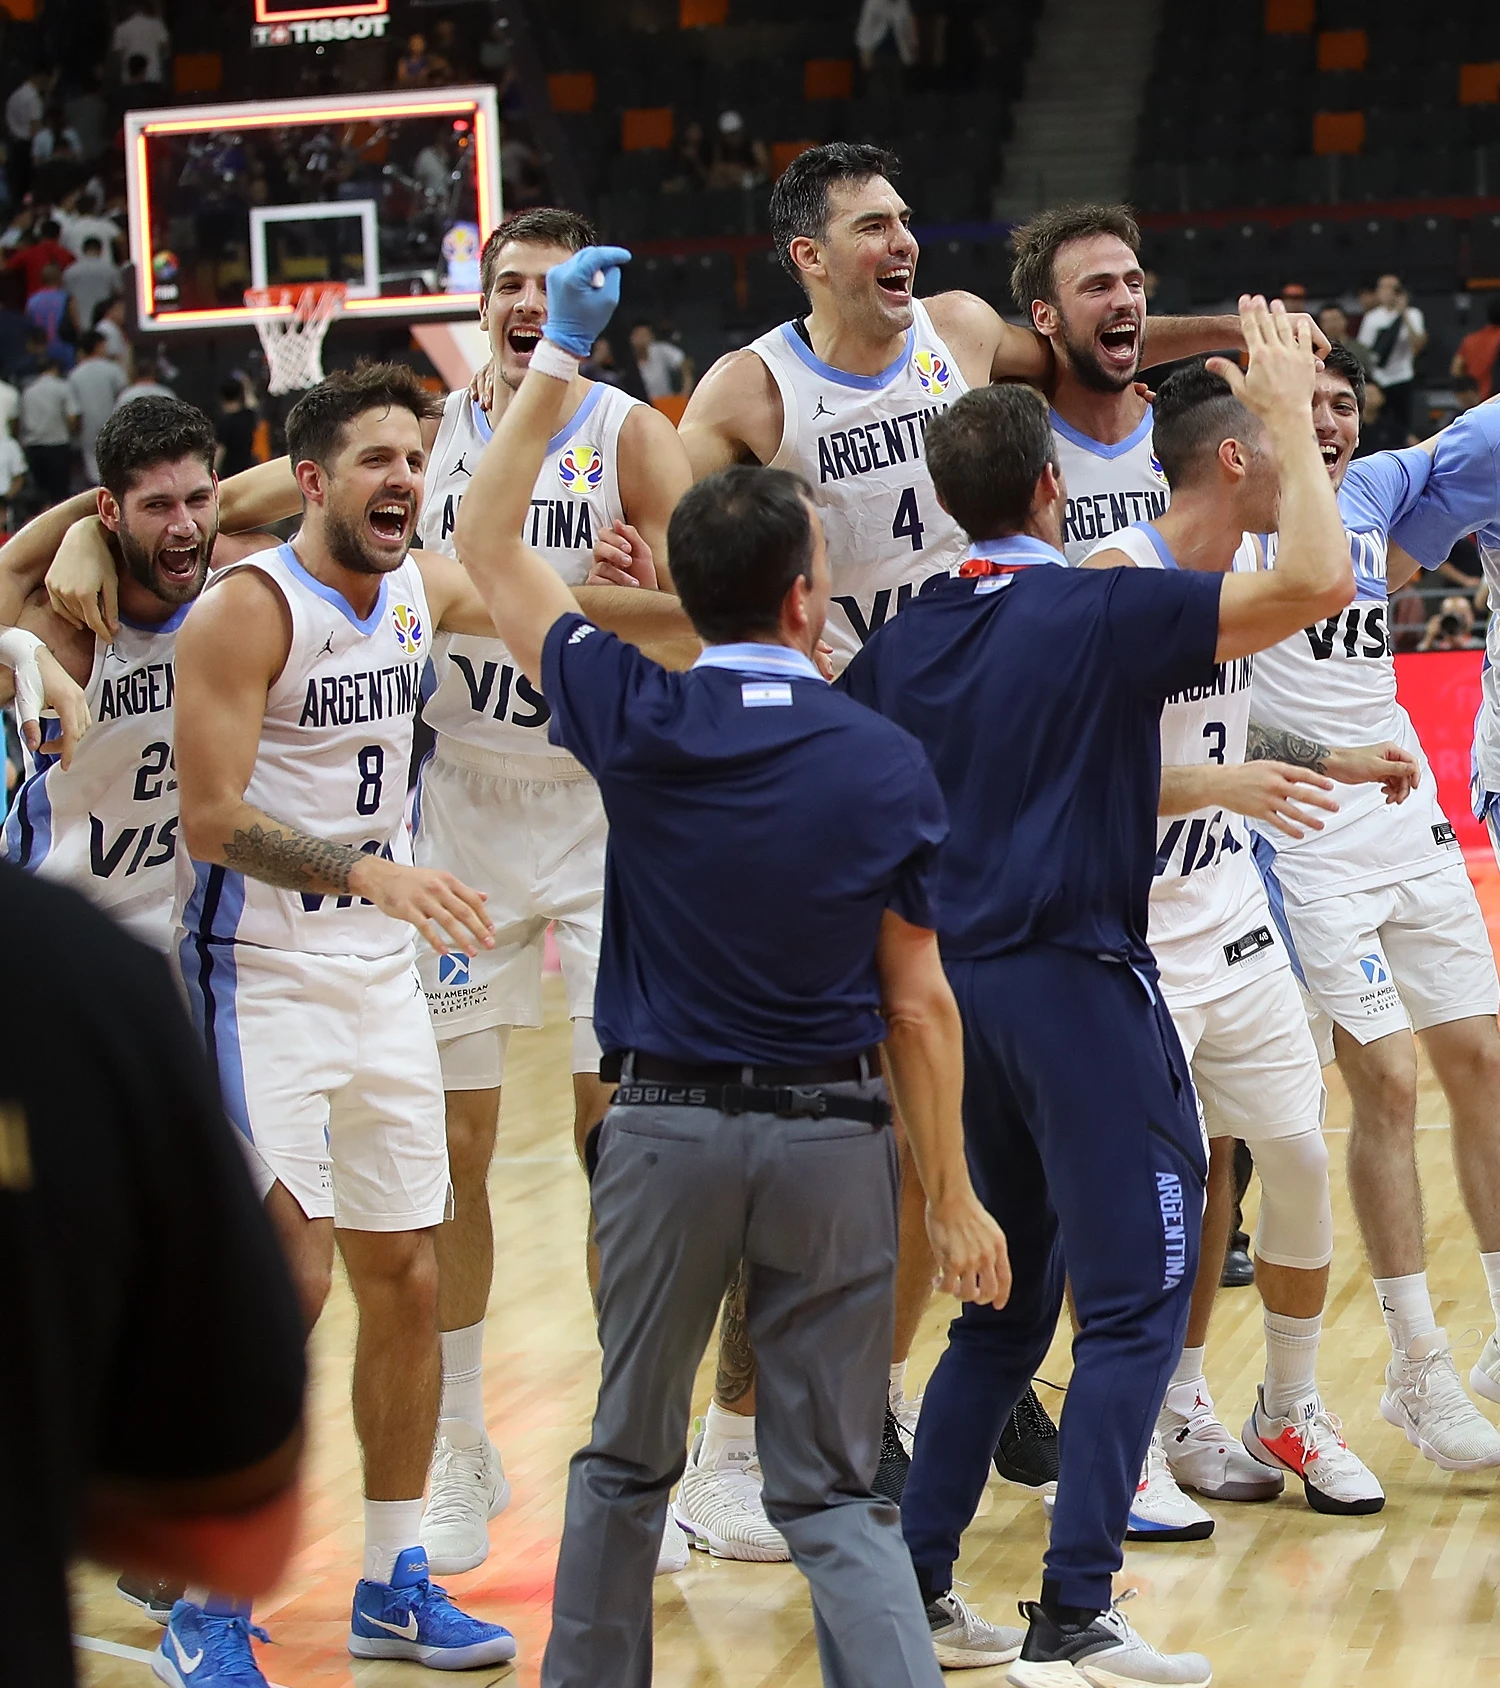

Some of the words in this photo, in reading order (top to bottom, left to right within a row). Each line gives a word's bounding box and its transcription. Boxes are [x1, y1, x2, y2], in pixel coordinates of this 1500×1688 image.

[892, 487, 925, 551] 4
[1203, 722, 1226, 765] 3
[356, 745, 384, 815] 8
[433, 996, 488, 1014] RGENTINA
[443, 984, 489, 999] AMERICAN
[1156, 1172, 1185, 1290] ARGENTINA
